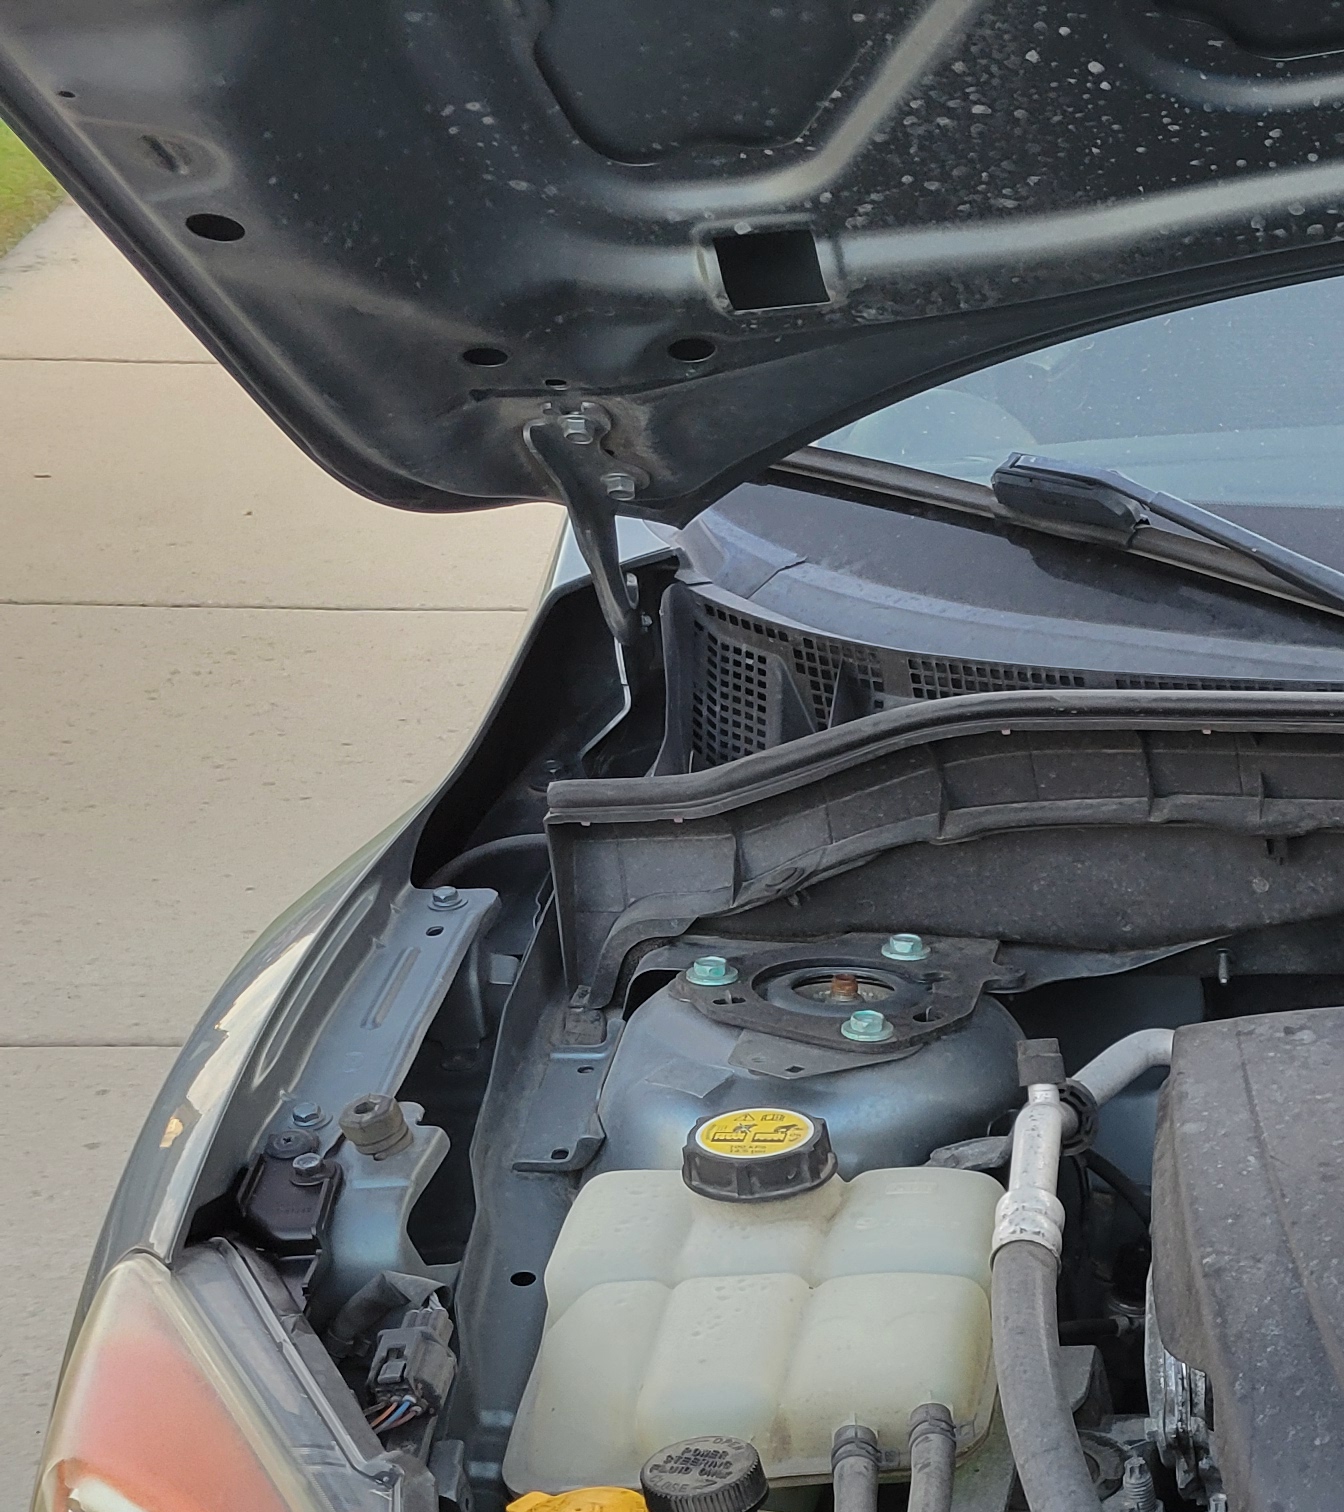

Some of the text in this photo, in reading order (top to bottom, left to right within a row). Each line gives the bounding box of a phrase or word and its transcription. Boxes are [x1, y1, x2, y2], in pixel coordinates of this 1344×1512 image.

[681, 1447, 729, 1460] POWER
[663, 1455, 733, 1469] STEERING
[649, 1463, 733, 1479] FLUID ONLY
[649, 1474, 690, 1493] CLOSE
